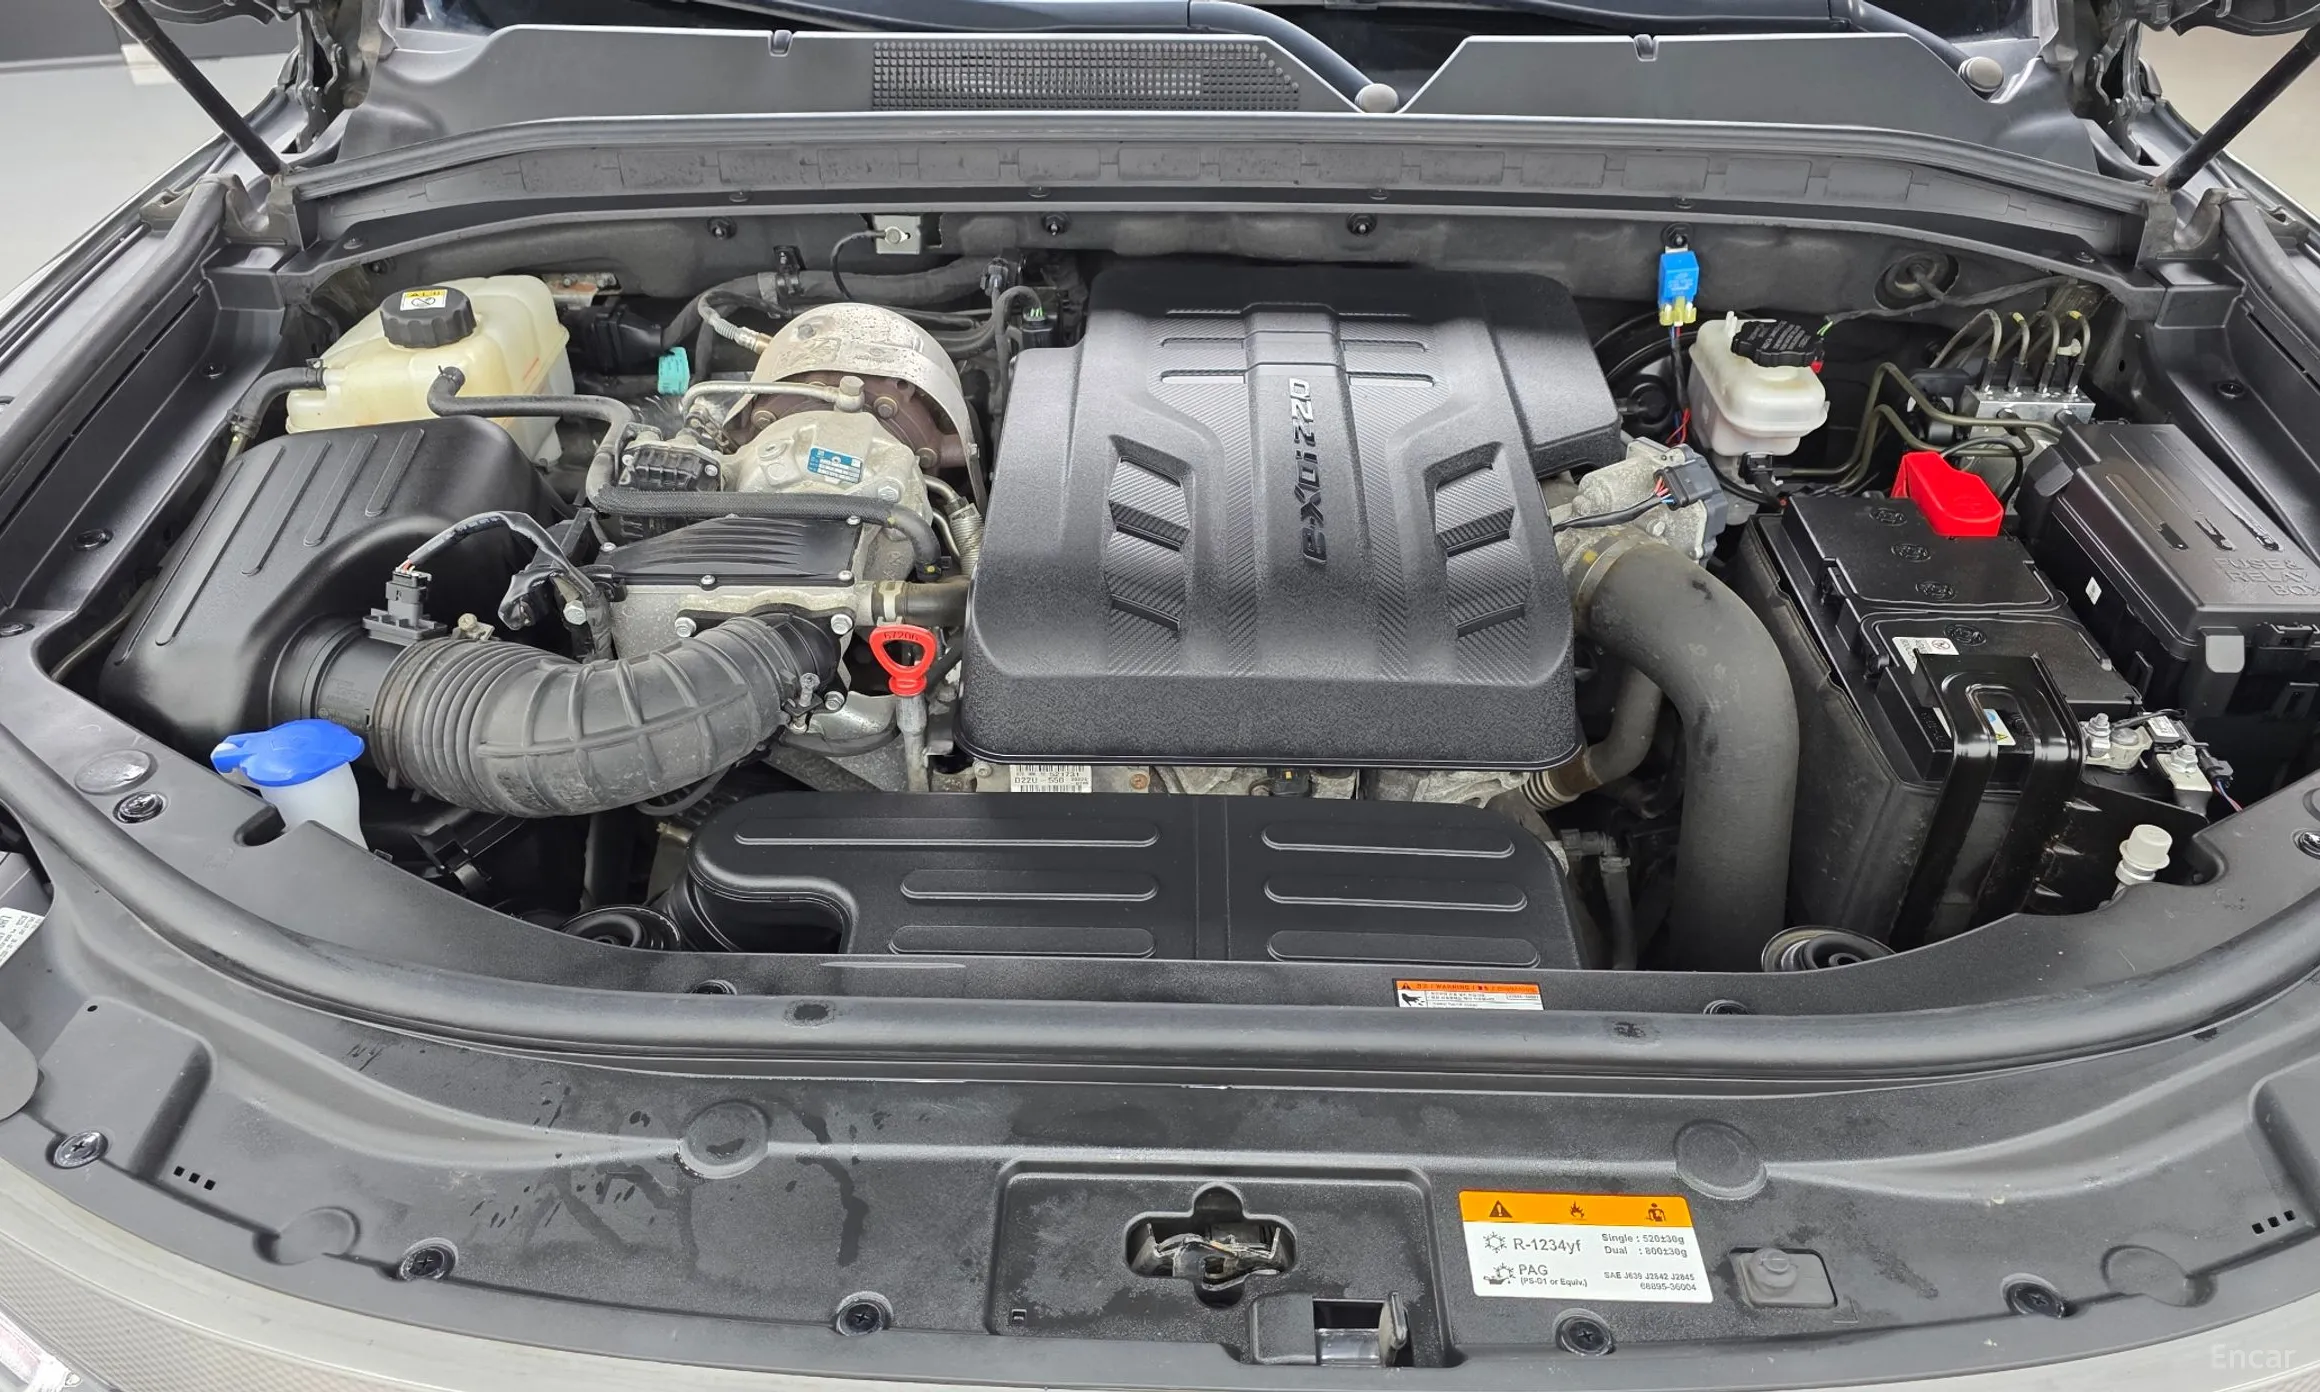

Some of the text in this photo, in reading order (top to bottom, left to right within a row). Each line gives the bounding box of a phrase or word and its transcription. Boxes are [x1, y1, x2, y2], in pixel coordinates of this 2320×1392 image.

[2224, 571, 2310, 583] RELAY
[1601, 1233, 1633, 1244] Single
[1642, 1234, 1685, 1245] 520±30g
[1513, 1237, 1582, 1255] R-1234yf
[1604, 1245, 1628, 1255] Dual
[1644, 1247, 1688, 1258] 800±30g
[1518, 1263, 1549, 1276] PAG
[1603, 1271, 1622, 1279] SAE
